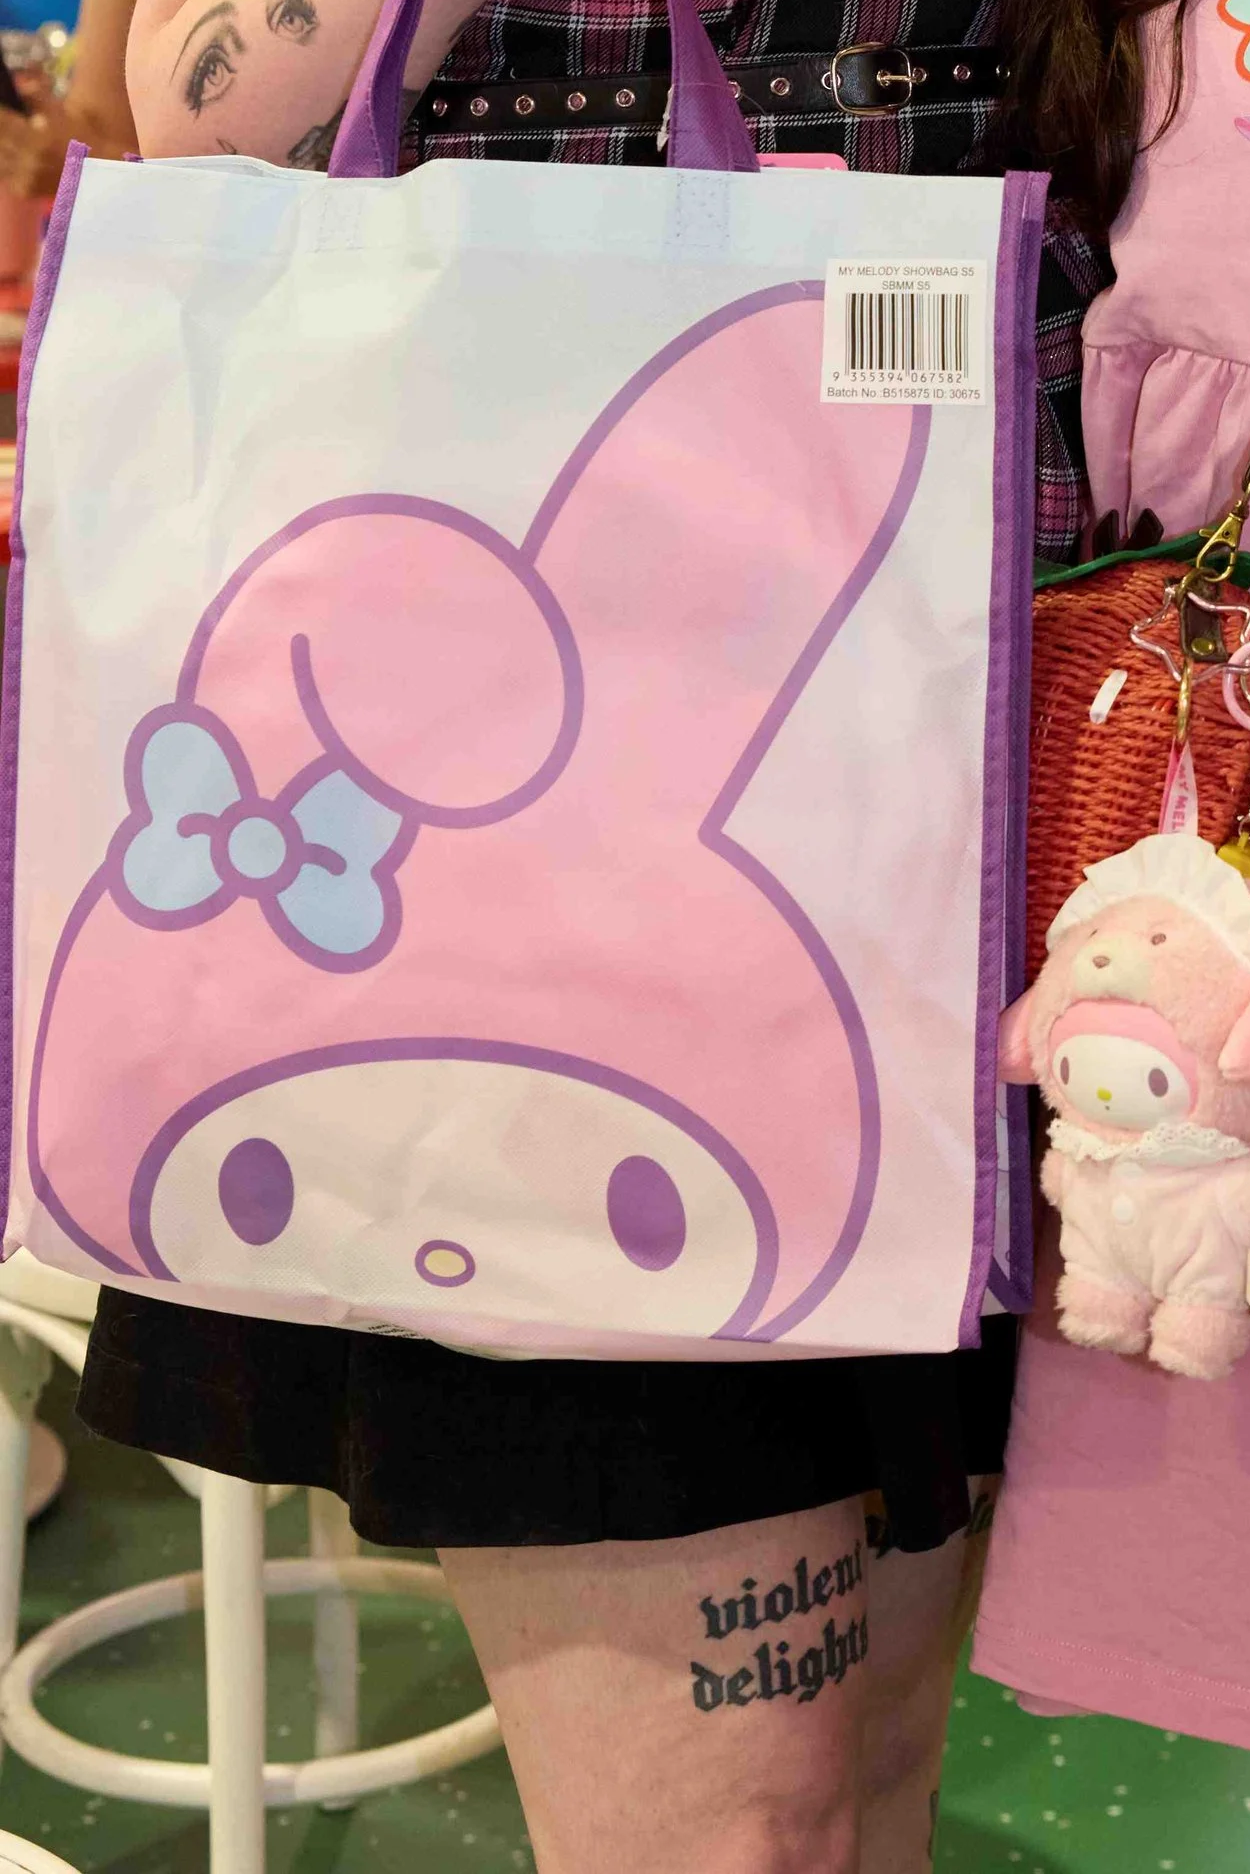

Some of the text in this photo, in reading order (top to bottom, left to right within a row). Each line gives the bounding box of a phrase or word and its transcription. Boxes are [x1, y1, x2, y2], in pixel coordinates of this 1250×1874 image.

[838, 267, 975, 277] MY MELODY SHOWBAG S5
[882, 281, 930, 290] SBMM S5
[827, 387, 858, 398] Batch
[949, 389, 981, 399] 30675
[1171, 795, 1188, 833] MEL
